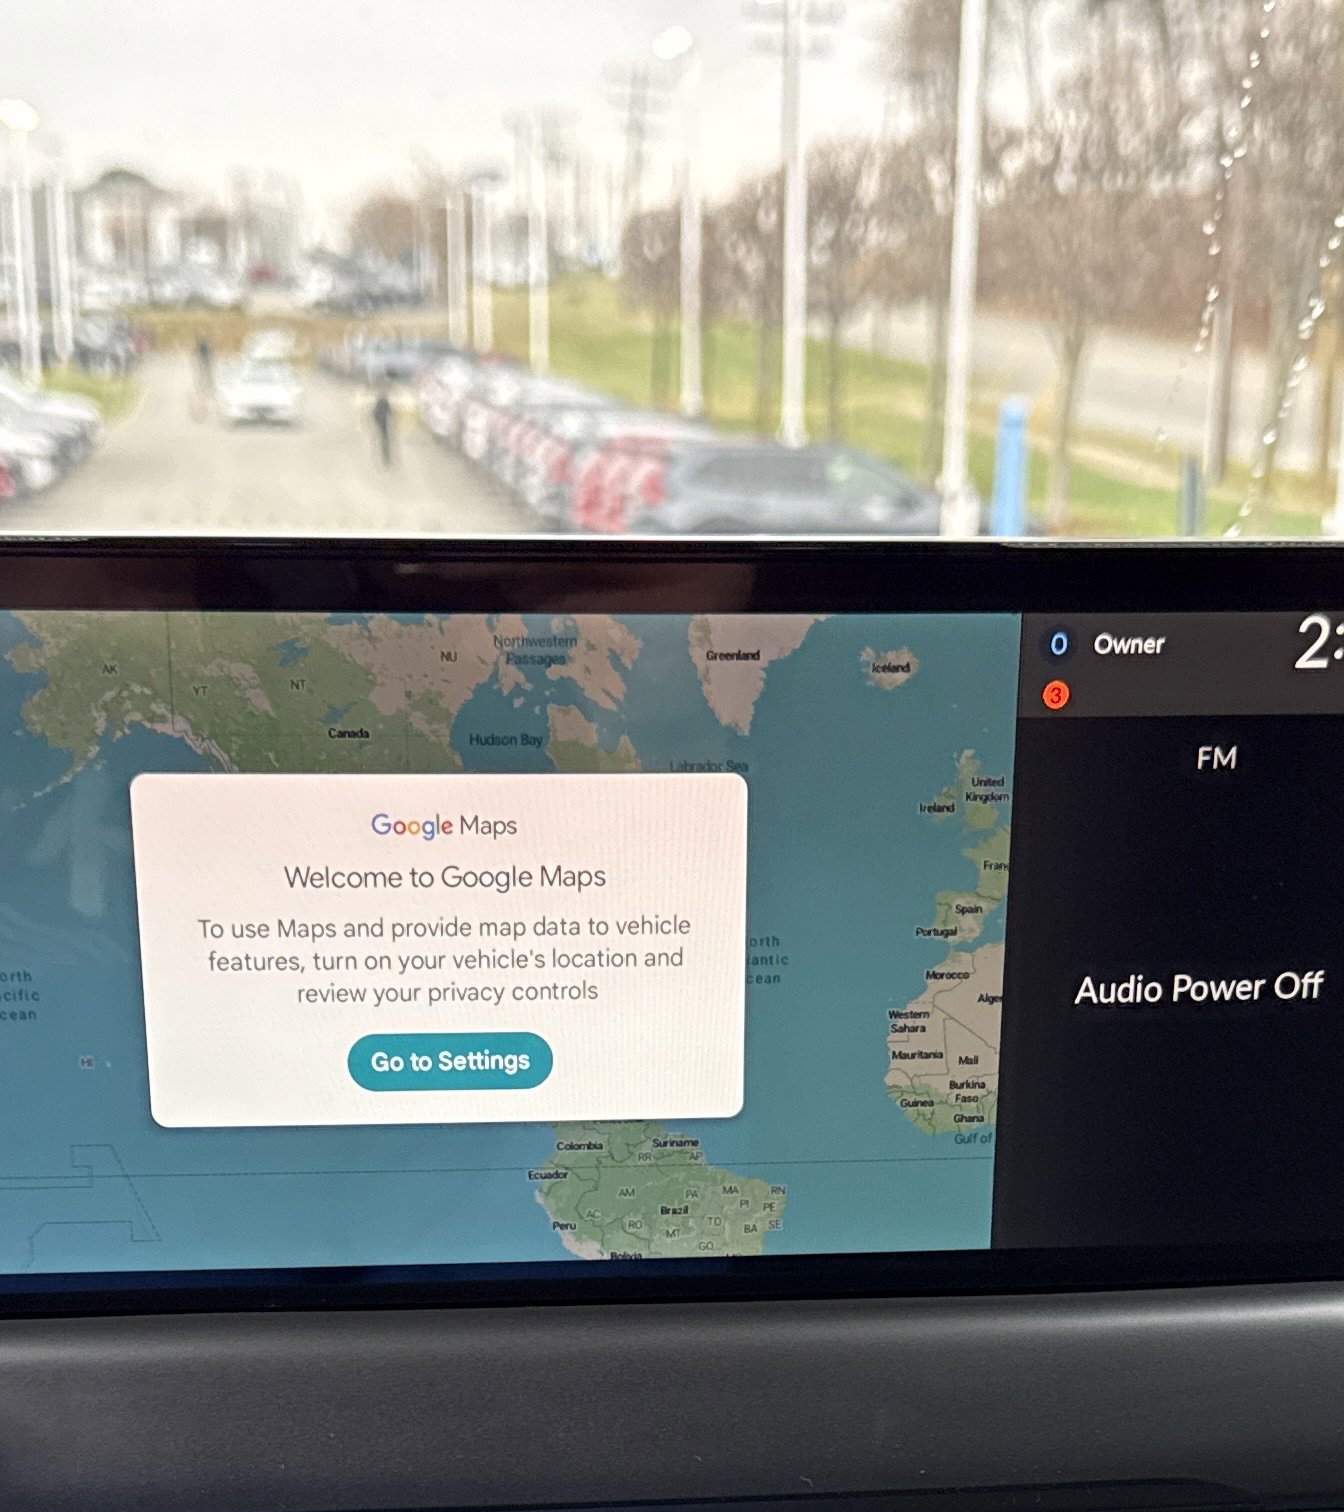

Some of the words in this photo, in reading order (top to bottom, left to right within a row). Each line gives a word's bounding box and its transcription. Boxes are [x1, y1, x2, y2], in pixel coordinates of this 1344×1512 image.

[493, 634, 578, 648] Northwestern
[1093, 632, 1166, 655] Owner
[440, 651, 458, 663] NU
[506, 653, 566, 667] Passages
[706, 650, 761, 662] Greenland
[102, 664, 118, 675] AK
[872, 662, 911, 673] Iceland
[290, 679, 306, 690] NT
[192, 685, 208, 697] YT
[1050, 687, 1062, 704] 3
[327, 727, 370, 739] Canada
[469, 734, 517, 747] Hudson
[521, 734, 543, 749] Bay
[1197, 745, 1238, 770] FM
[669, 760, 723, 772] Labrador
[726, 760, 749, 772] Sea
[971, 776, 1004, 787] United
[966, 792, 1009, 804] Kingdom
[920, 803, 955, 814] Ireland
[371, 813, 453, 841] Google
[460, 815, 518, 840] Maps
[283, 865, 403, 889] Welcome
[409, 867, 435, 888] to
[441, 865, 533, 893] Google
[540, 865, 606, 893] Maps
[955, 904, 983, 916] Spain
[197, 919, 224, 939] To
[231, 923, 270, 939] use
[277, 919, 337, 943] Maps
[343, 916, 384, 938] and
[391, 916, 472, 942] provide
[479, 920, 526, 941] map
[533, 916, 580, 937] data
[588, 917, 609, 936] to
[615, 914, 691, 935] vehicle
[915, 926, 958, 939] Portugal
[749, 934, 780, 947] orth
[208, 950, 306, 973] features,
[313, 952, 357, 971] turn
[364, 954, 391, 970] on
[398, 953, 446, 975] your
[452, 949, 545, 970] vehicle's
[552, 947, 638, 969] location
[644, 946, 684, 967] and
[747, 974, 781, 985] cean
[926, 970, 970, 980] Morocco
[1074, 974, 1163, 1004] Audio
[1172, 973, 1266, 1002] Power
[1274, 969, 1325, 1000] Off
[297, 982, 366, 1003] review
[373, 986, 421, 1007] your
[428, 981, 505, 1006] privacy
[512, 980, 599, 1001] controls
[888, 1010, 930, 1020] Western
[890, 1024, 926, 1033] Sahara
[892, 1050, 943, 1060] Mauritania
[958, 1055, 979, 1066] Mali
[371, 1051, 405, 1072] Go
[409, 1052, 433, 1072] to
[438, 1048, 531, 1075] Settings
[949, 1080, 986, 1090] Burkina
[900, 1098, 934, 1108] Guinea
[955, 1093, 979, 1103] Faso
[954, 1113, 984, 1123] Ghana
[652, 1138, 700, 1148] Suriname
[954, 1132, 977, 1144] Gulf
[979, 1132, 992, 1143] of
[556, 1141, 603, 1151] Colombia
[528, 1170, 568, 1180] Ecuador
[618, 1188, 635, 1197] AM
[660, 1205, 689, 1215] Brazil
[553, 1222, 576, 1231] Peru
